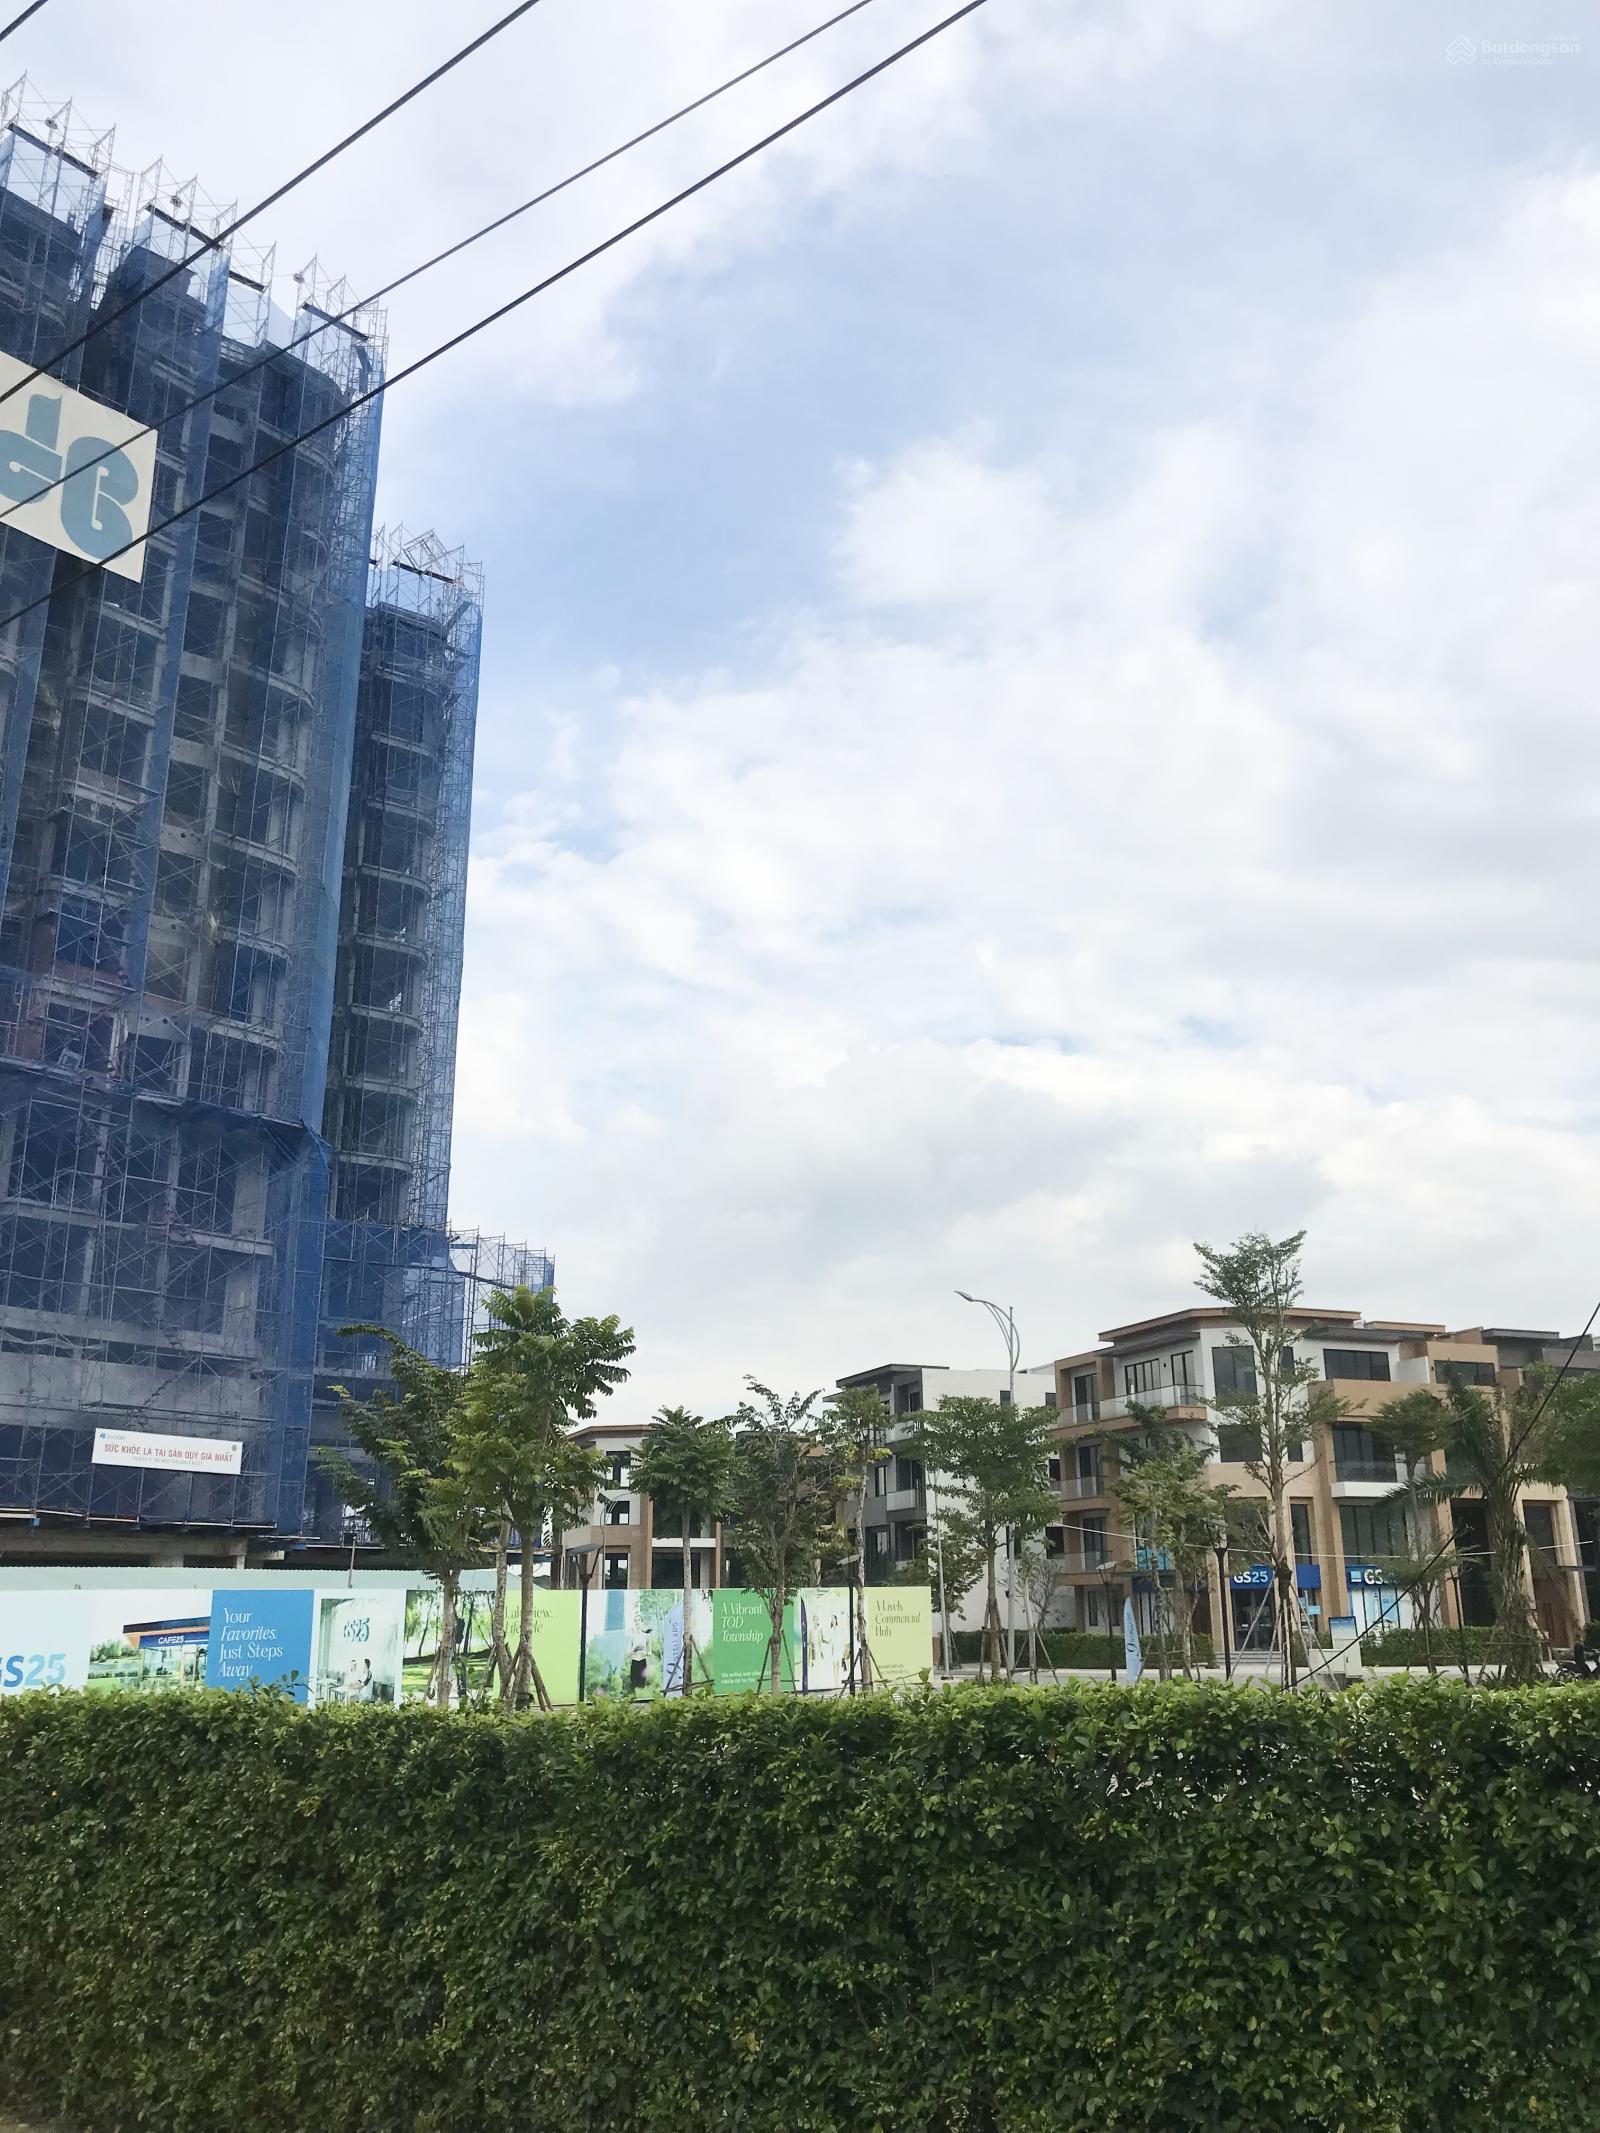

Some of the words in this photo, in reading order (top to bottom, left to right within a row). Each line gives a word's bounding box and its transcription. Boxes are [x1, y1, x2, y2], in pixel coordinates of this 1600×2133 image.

[1233, 1570, 1269, 1584] GS25
[224, 1607, 253, 1624] Your
[730, 1602, 762, 1615] Vibrant
[721, 1616, 744, 1630] TOD
[875, 1612, 921, 1625] Commercial
[220, 1625, 278, 1641] Favorites.
[721, 1630, 763, 1644] Township
[875, 1625, 892, 1637] Hub
[219, 1643, 242, 1663] Just
[247, 1641, 283, 1661] Steps
[0, 1653, 66, 1688] S25
[216, 1661, 253, 1680] Away
